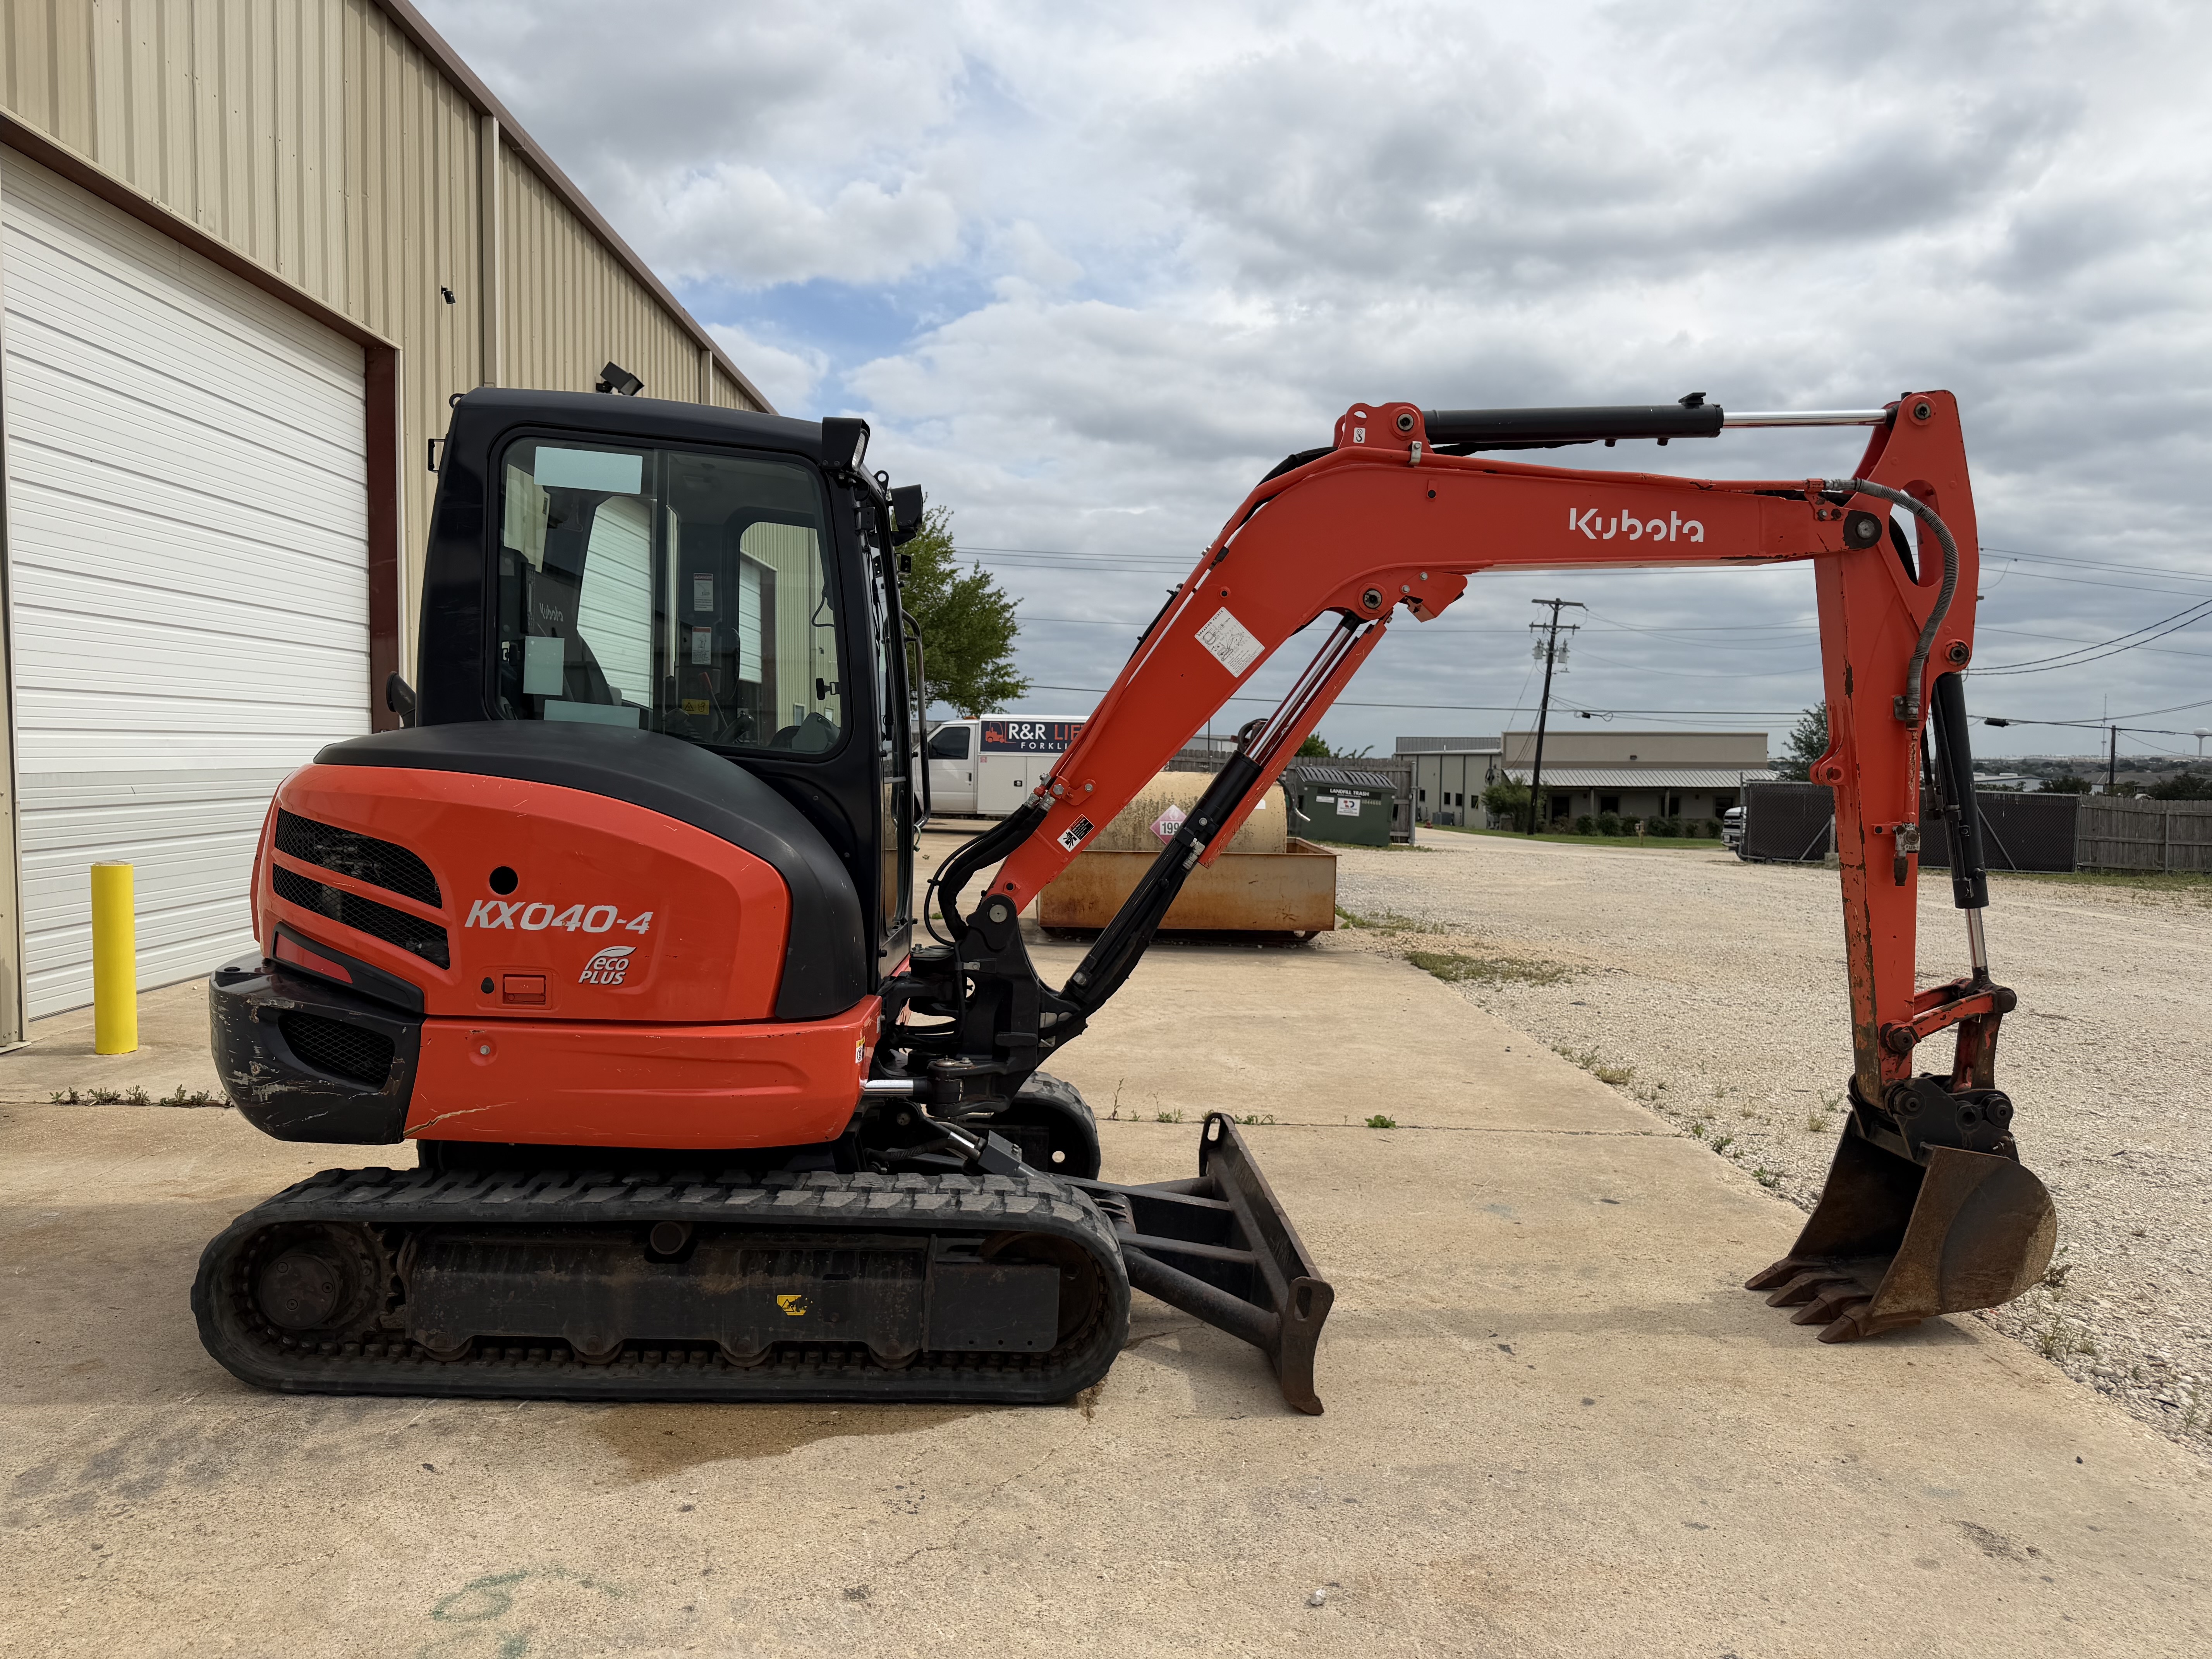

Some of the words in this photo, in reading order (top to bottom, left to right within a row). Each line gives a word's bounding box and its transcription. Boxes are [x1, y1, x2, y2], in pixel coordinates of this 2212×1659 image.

[1569, 508, 1704, 542] Kubota
[539, 603, 563, 622] Kubota
[1212, 610, 1223, 621] POINTS
[1008, 723, 1047, 740] R&R
[1054, 725, 1084, 740] LIF
[1021, 742, 1067, 750] FORKLI
[1162, 822, 1180, 834] 199
[465, 900, 654, 934] KX040-4
[578, 970, 626, 985] PLUS
